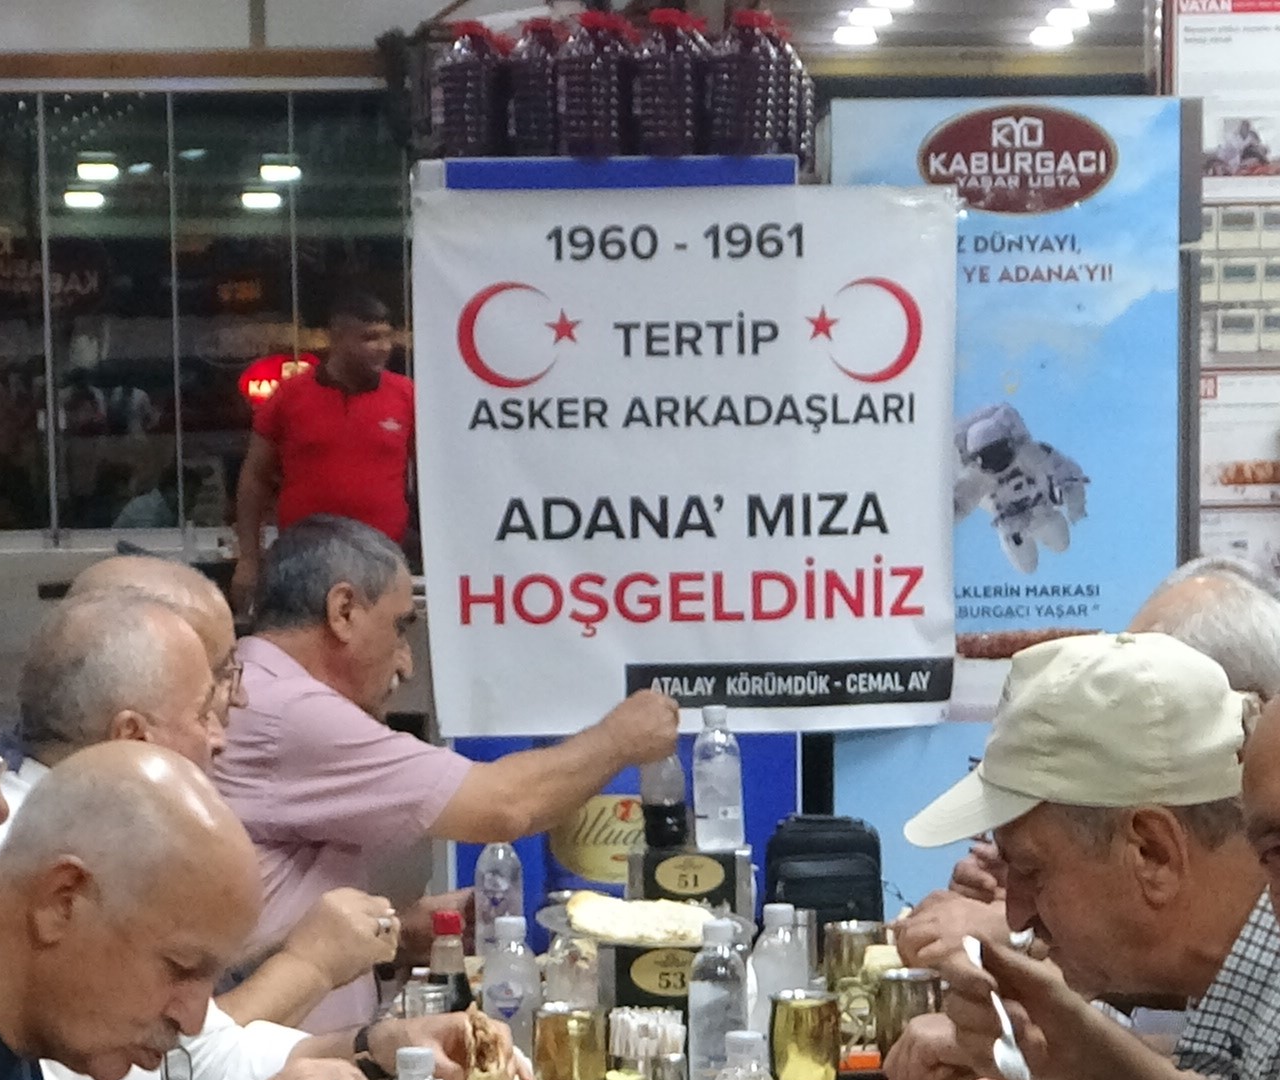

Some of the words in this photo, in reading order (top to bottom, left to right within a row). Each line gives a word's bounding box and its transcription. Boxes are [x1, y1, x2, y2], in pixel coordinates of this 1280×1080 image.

[928, 150, 1107, 176] KABURGACI
[1028, 175, 1081, 188] USTA
[545, 224, 658, 261] 1960
[703, 223, 805, 259] 1961
[973, 231, 1082, 254] DÜNYAYI,
[963, 266, 990, 283] YE
[614, 311, 779, 358] TERTİP
[468, 397, 609, 430] ASKER
[622, 393, 915, 434] ARKADAŞLARI
[747, 492, 889, 538] MIZA
[459, 554, 925, 638] HOŞGELDİNİZ
[955, 582, 1020, 599] LKLERİN
[1025, 584, 1100, 597] MARKASI
[956, 606, 1030, 619] BURGACI
[1035, 605, 1088, 619] YAŞAR
[650, 676, 717, 696] ATALAY
[726, 671, 831, 696] KÖRÜMDÜK
[846, 672, 905, 694] CEMAL
[907, 671, 931, 691] AY
[677, 874, 699, 889] 51
[658, 971, 686, 990] 53
